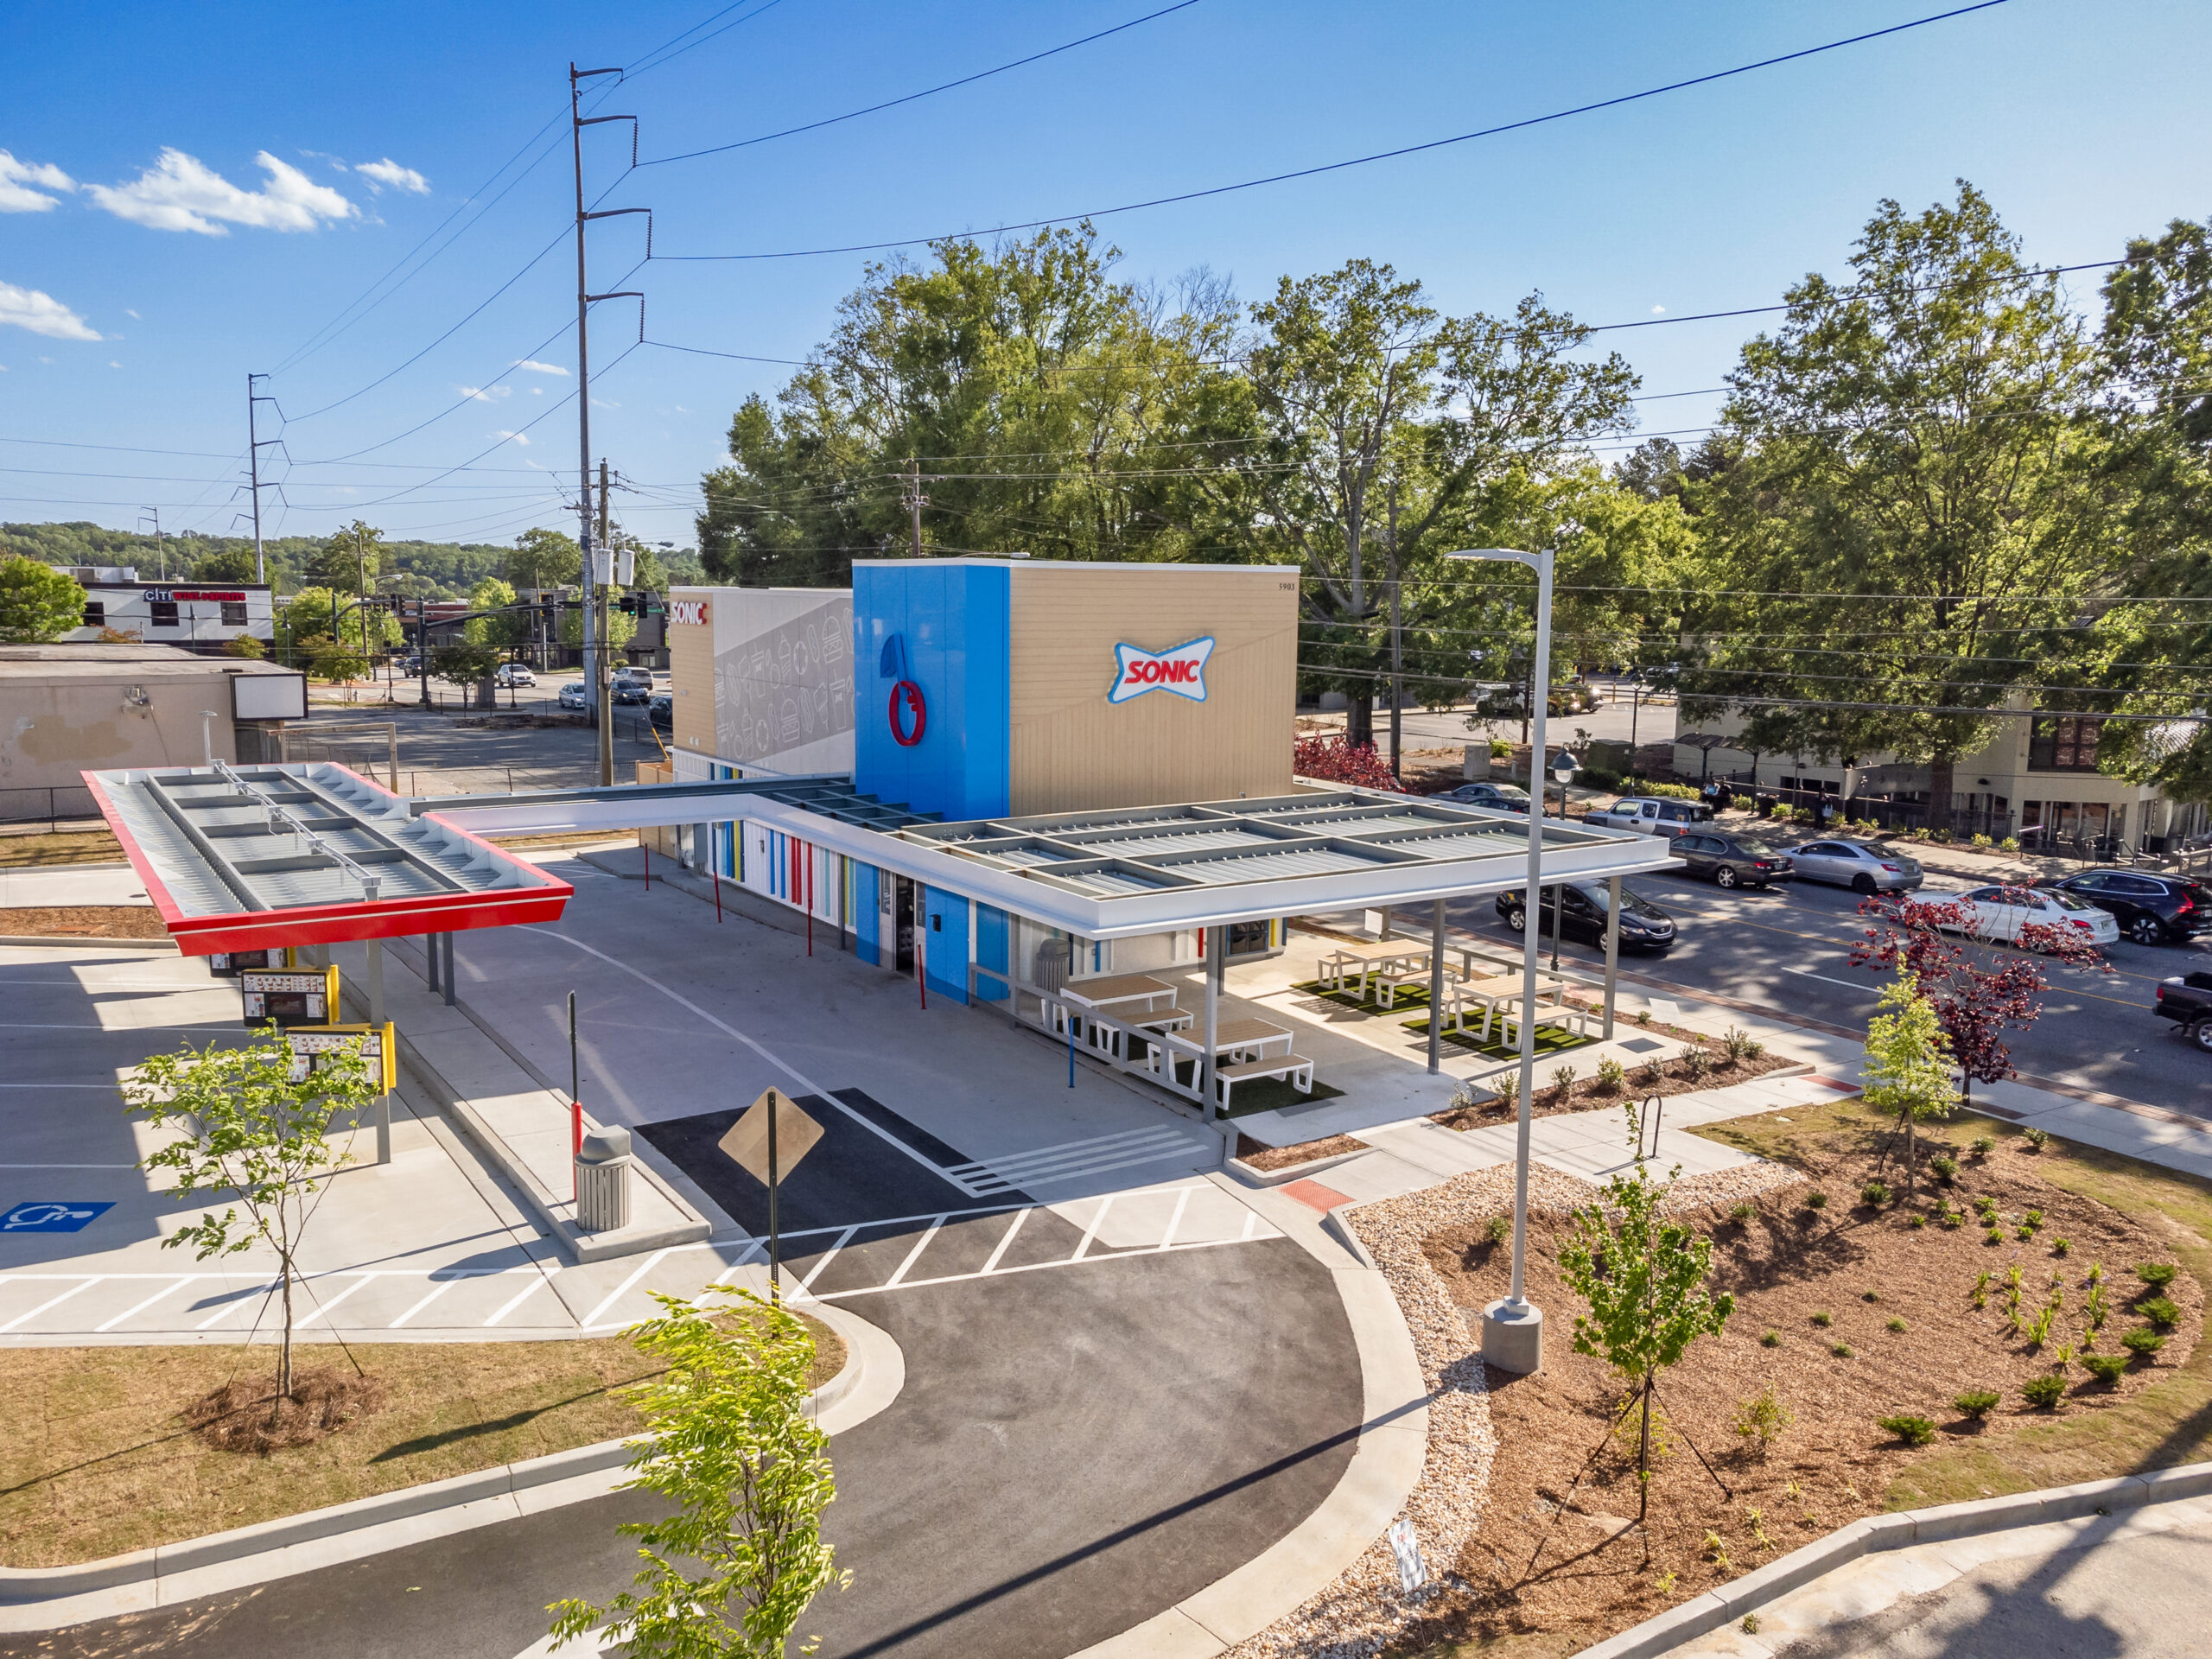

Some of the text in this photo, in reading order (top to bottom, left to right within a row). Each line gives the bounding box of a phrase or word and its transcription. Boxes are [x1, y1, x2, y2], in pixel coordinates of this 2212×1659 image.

[1279, 582, 1295, 591] 5903
[671, 601, 706, 625] SONIC
[1124, 659, 1200, 684] SONIC
